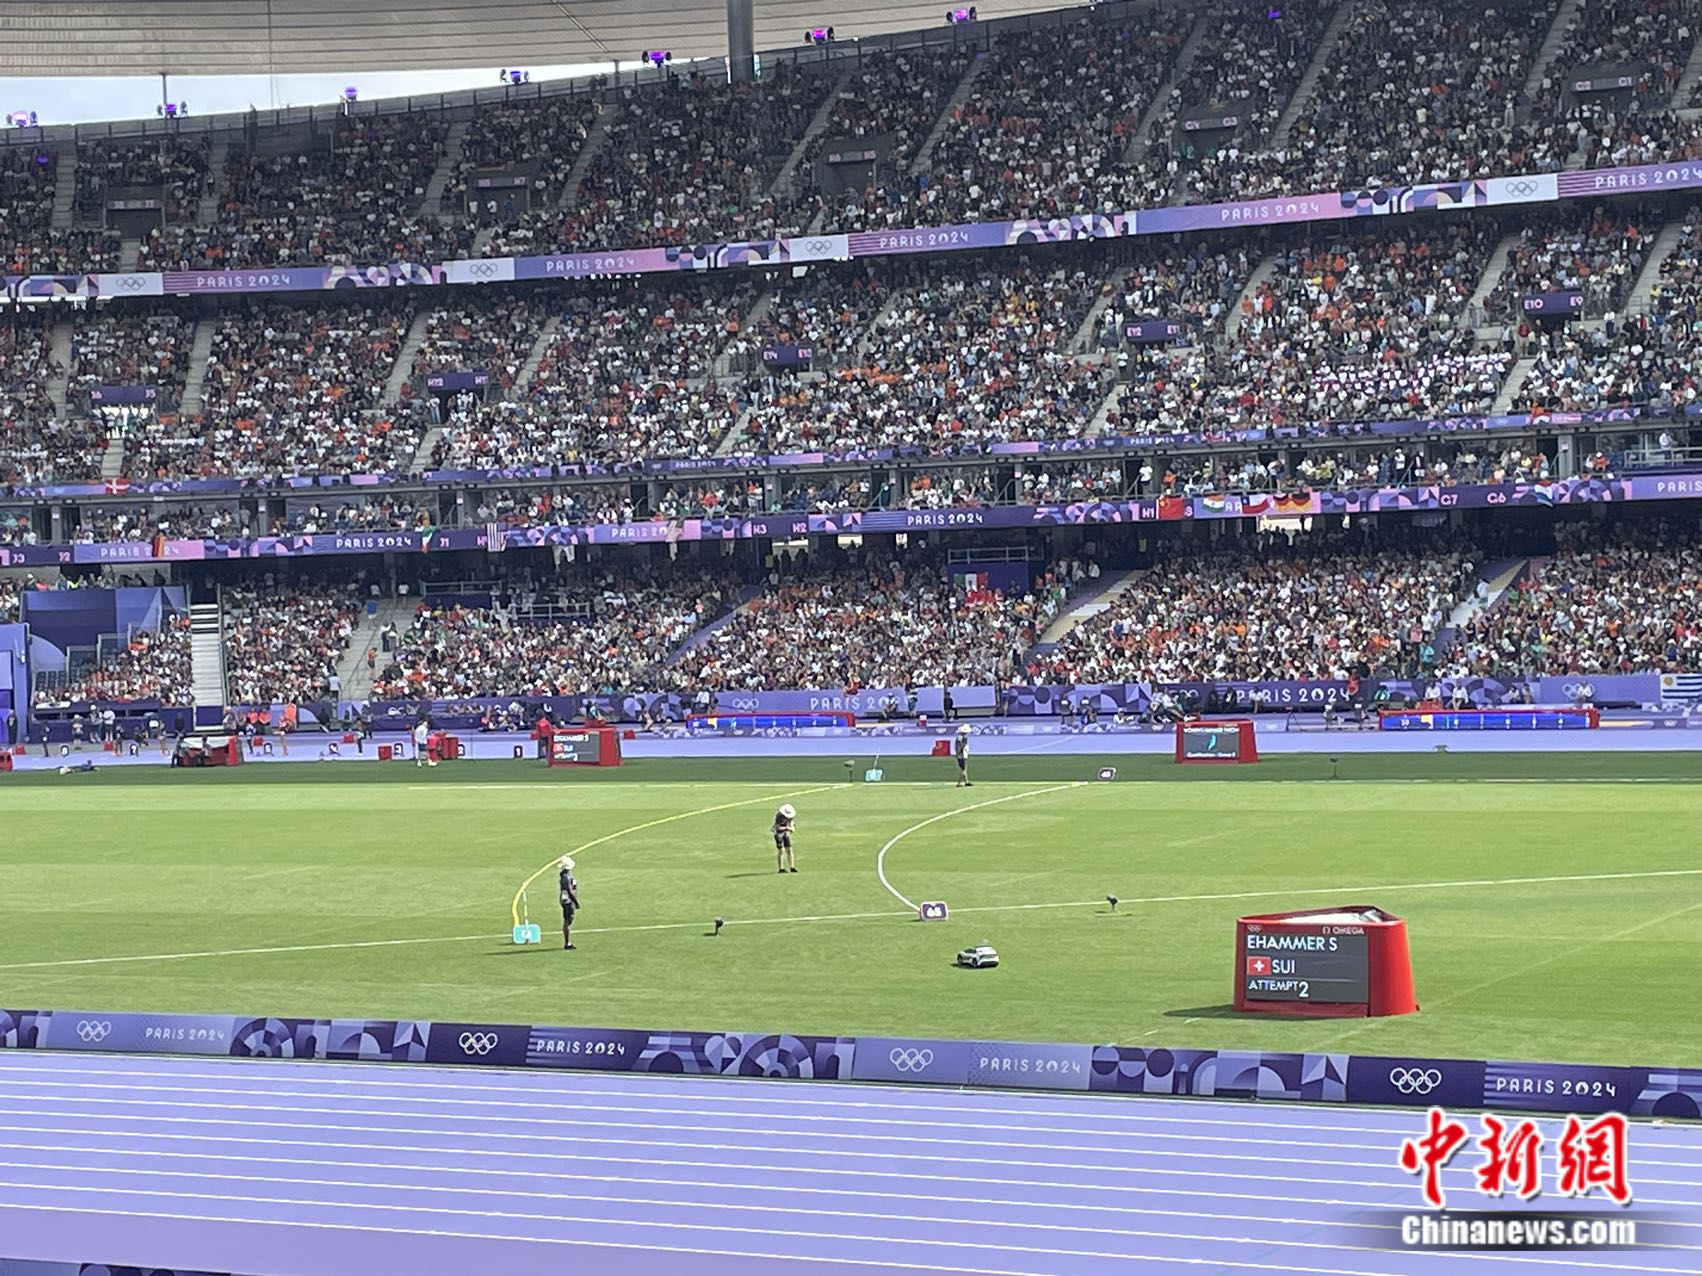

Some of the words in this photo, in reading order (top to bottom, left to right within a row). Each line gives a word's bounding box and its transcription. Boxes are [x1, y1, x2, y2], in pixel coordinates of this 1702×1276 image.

[1595, 172, 1648, 189] PARIS
[1654, 167, 1702, 184] 2024
[1221, 206, 1269, 221] PARIS
[1275, 202, 1319, 217] 2024
[880, 235, 923, 249] PARIS
[928, 231, 969, 246] 2024
[546, 259, 590, 273] PARIS
[594, 256, 635, 270] 2024
[196, 276, 243, 288] PARIS
[248, 274, 290, 287] 2024
[1524, 298, 1544, 310] E10
[1570, 296, 1584, 307] E9
[1657, 480, 1702, 493] PARIS
[907, 514, 945, 526] PARIS
[948, 512, 983, 525] 2024
[1142, 507, 1155, 519] H1
[611, 526, 648, 538] PARIS
[753, 523, 767, 535] H3
[792, 522, 807, 534] H2
[336, 537, 374, 549] PARIS
[377, 536, 412, 548] 2024
[101, 546, 140, 558] PARIS
[144, 546, 180, 557] 224
[1299, 687, 1350, 703] 2024
[1332, 926, 1365, 936] OMEGA
[1247, 934, 1325, 951] EHAMMER
[1329, 936, 1338, 952] S
[1271, 959, 1296, 974] SUI
[1248, 980, 1299, 991] ATTEMPT
[1298, 981, 1309, 998] 2
[145, 1027, 185, 1040] PARIS
[188, 1028, 225, 1041] 2024
[536, 1039, 581, 1054] PARIS
[584, 1041, 625, 1056] 2024
[980, 1057, 1029, 1072] PARIS
[1035, 1058, 1081, 1074] 2024
[1496, 1077, 1555, 1094] PARIS
[1562, 1080, 1616, 1097] 2024
